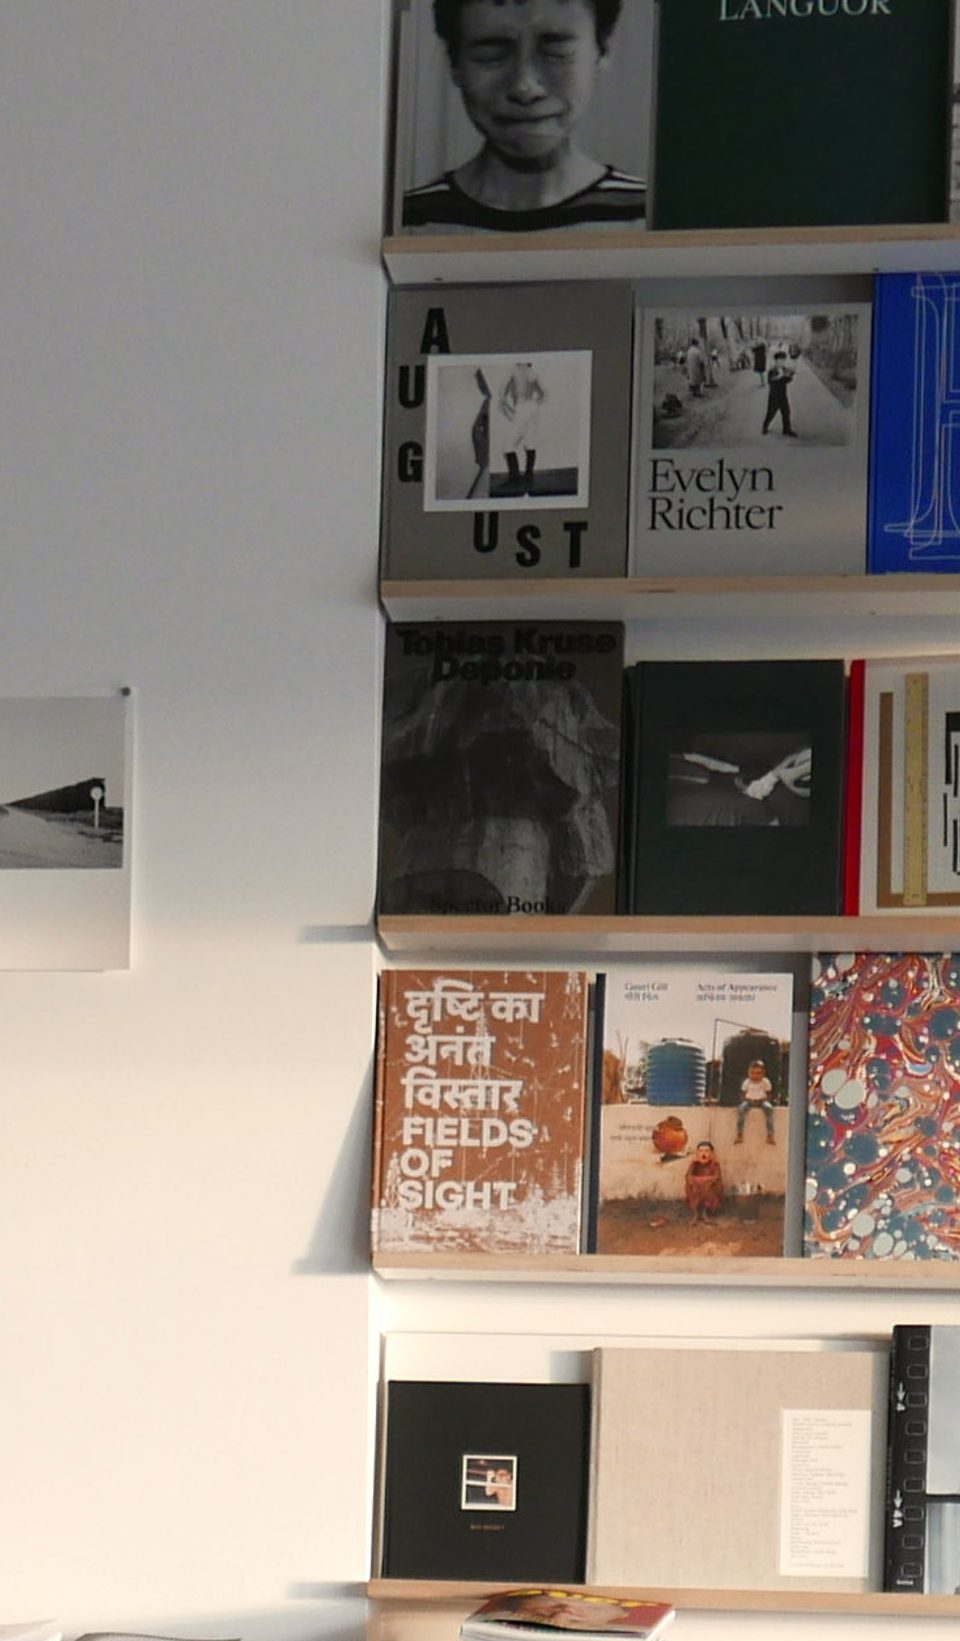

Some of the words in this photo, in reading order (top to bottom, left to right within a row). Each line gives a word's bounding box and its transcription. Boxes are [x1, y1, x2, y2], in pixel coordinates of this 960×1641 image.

[719, 0, 892, 21] LANGUOR
[648, 459, 775, 502] Evelyn
[648, 498, 784, 532] Richter
[396, 628, 505, 656] Tobias
[514, 627, 617, 654] Kruse
[431, 655, 577, 687] Deponie
[506, 895, 569, 914] Books
[697, 983, 715, 993] Acts
[717, 982, 726, 993] of
[728, 983, 778, 994] Appearance
[403, 978, 484, 1035] दृष्टि
[487, 991, 545, 1023] का
[404, 1026, 496, 1067] अनंत
[400, 1066, 524, 1113] विस्तार
[401, 1117, 534, 1149] FIELDS
[399, 1148, 453, 1179] OF
[398, 1180, 516, 1211] SIGHT
